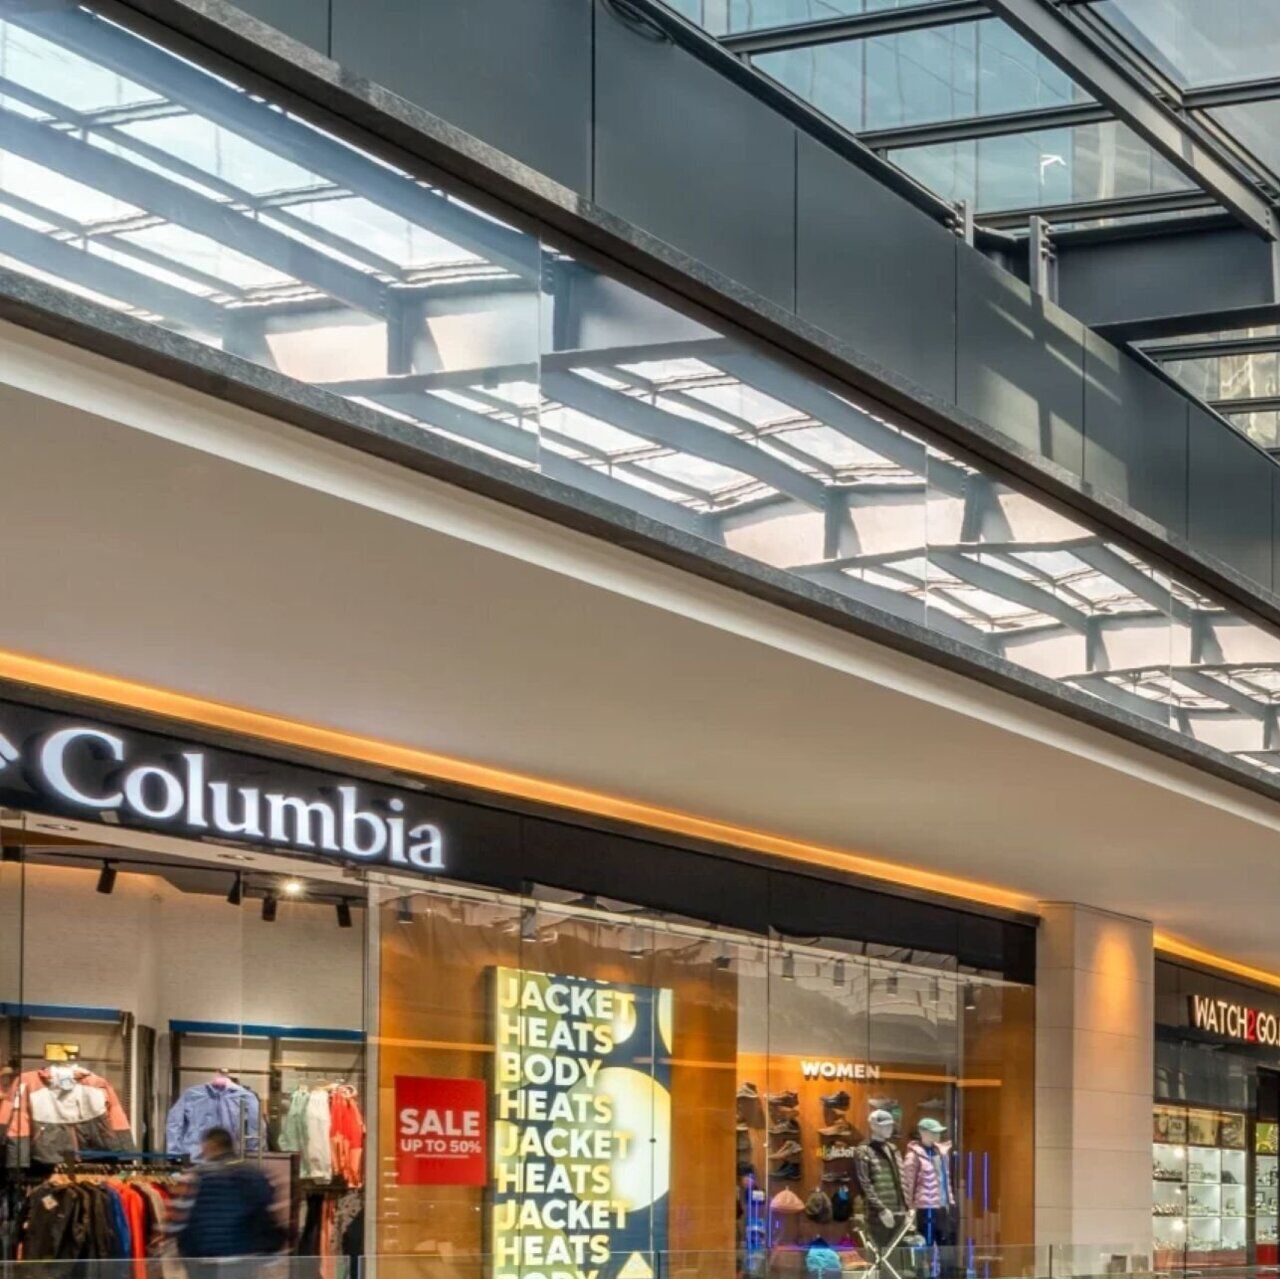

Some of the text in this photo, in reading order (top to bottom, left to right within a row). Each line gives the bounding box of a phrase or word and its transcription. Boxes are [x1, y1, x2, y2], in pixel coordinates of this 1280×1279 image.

[41, 728, 445, 869] Columbia
[500, 978, 635, 1021] JACKET
[500, 1013, 613, 1054] HEATS
[500, 1051, 602, 1088] BODY
[801, 1060, 880, 1079] WOMEN
[400, 1108, 480, 1137] SALE
[500, 1089, 613, 1124] HEATS
[401, 1138, 481, 1153] UP TO 50%
[496, 1125, 632, 1159] JACKET
[497, 1162, 611, 1195] HEATS
[495, 1199, 628, 1230] JACKET
[497, 1234, 609, 1267] HEATS
